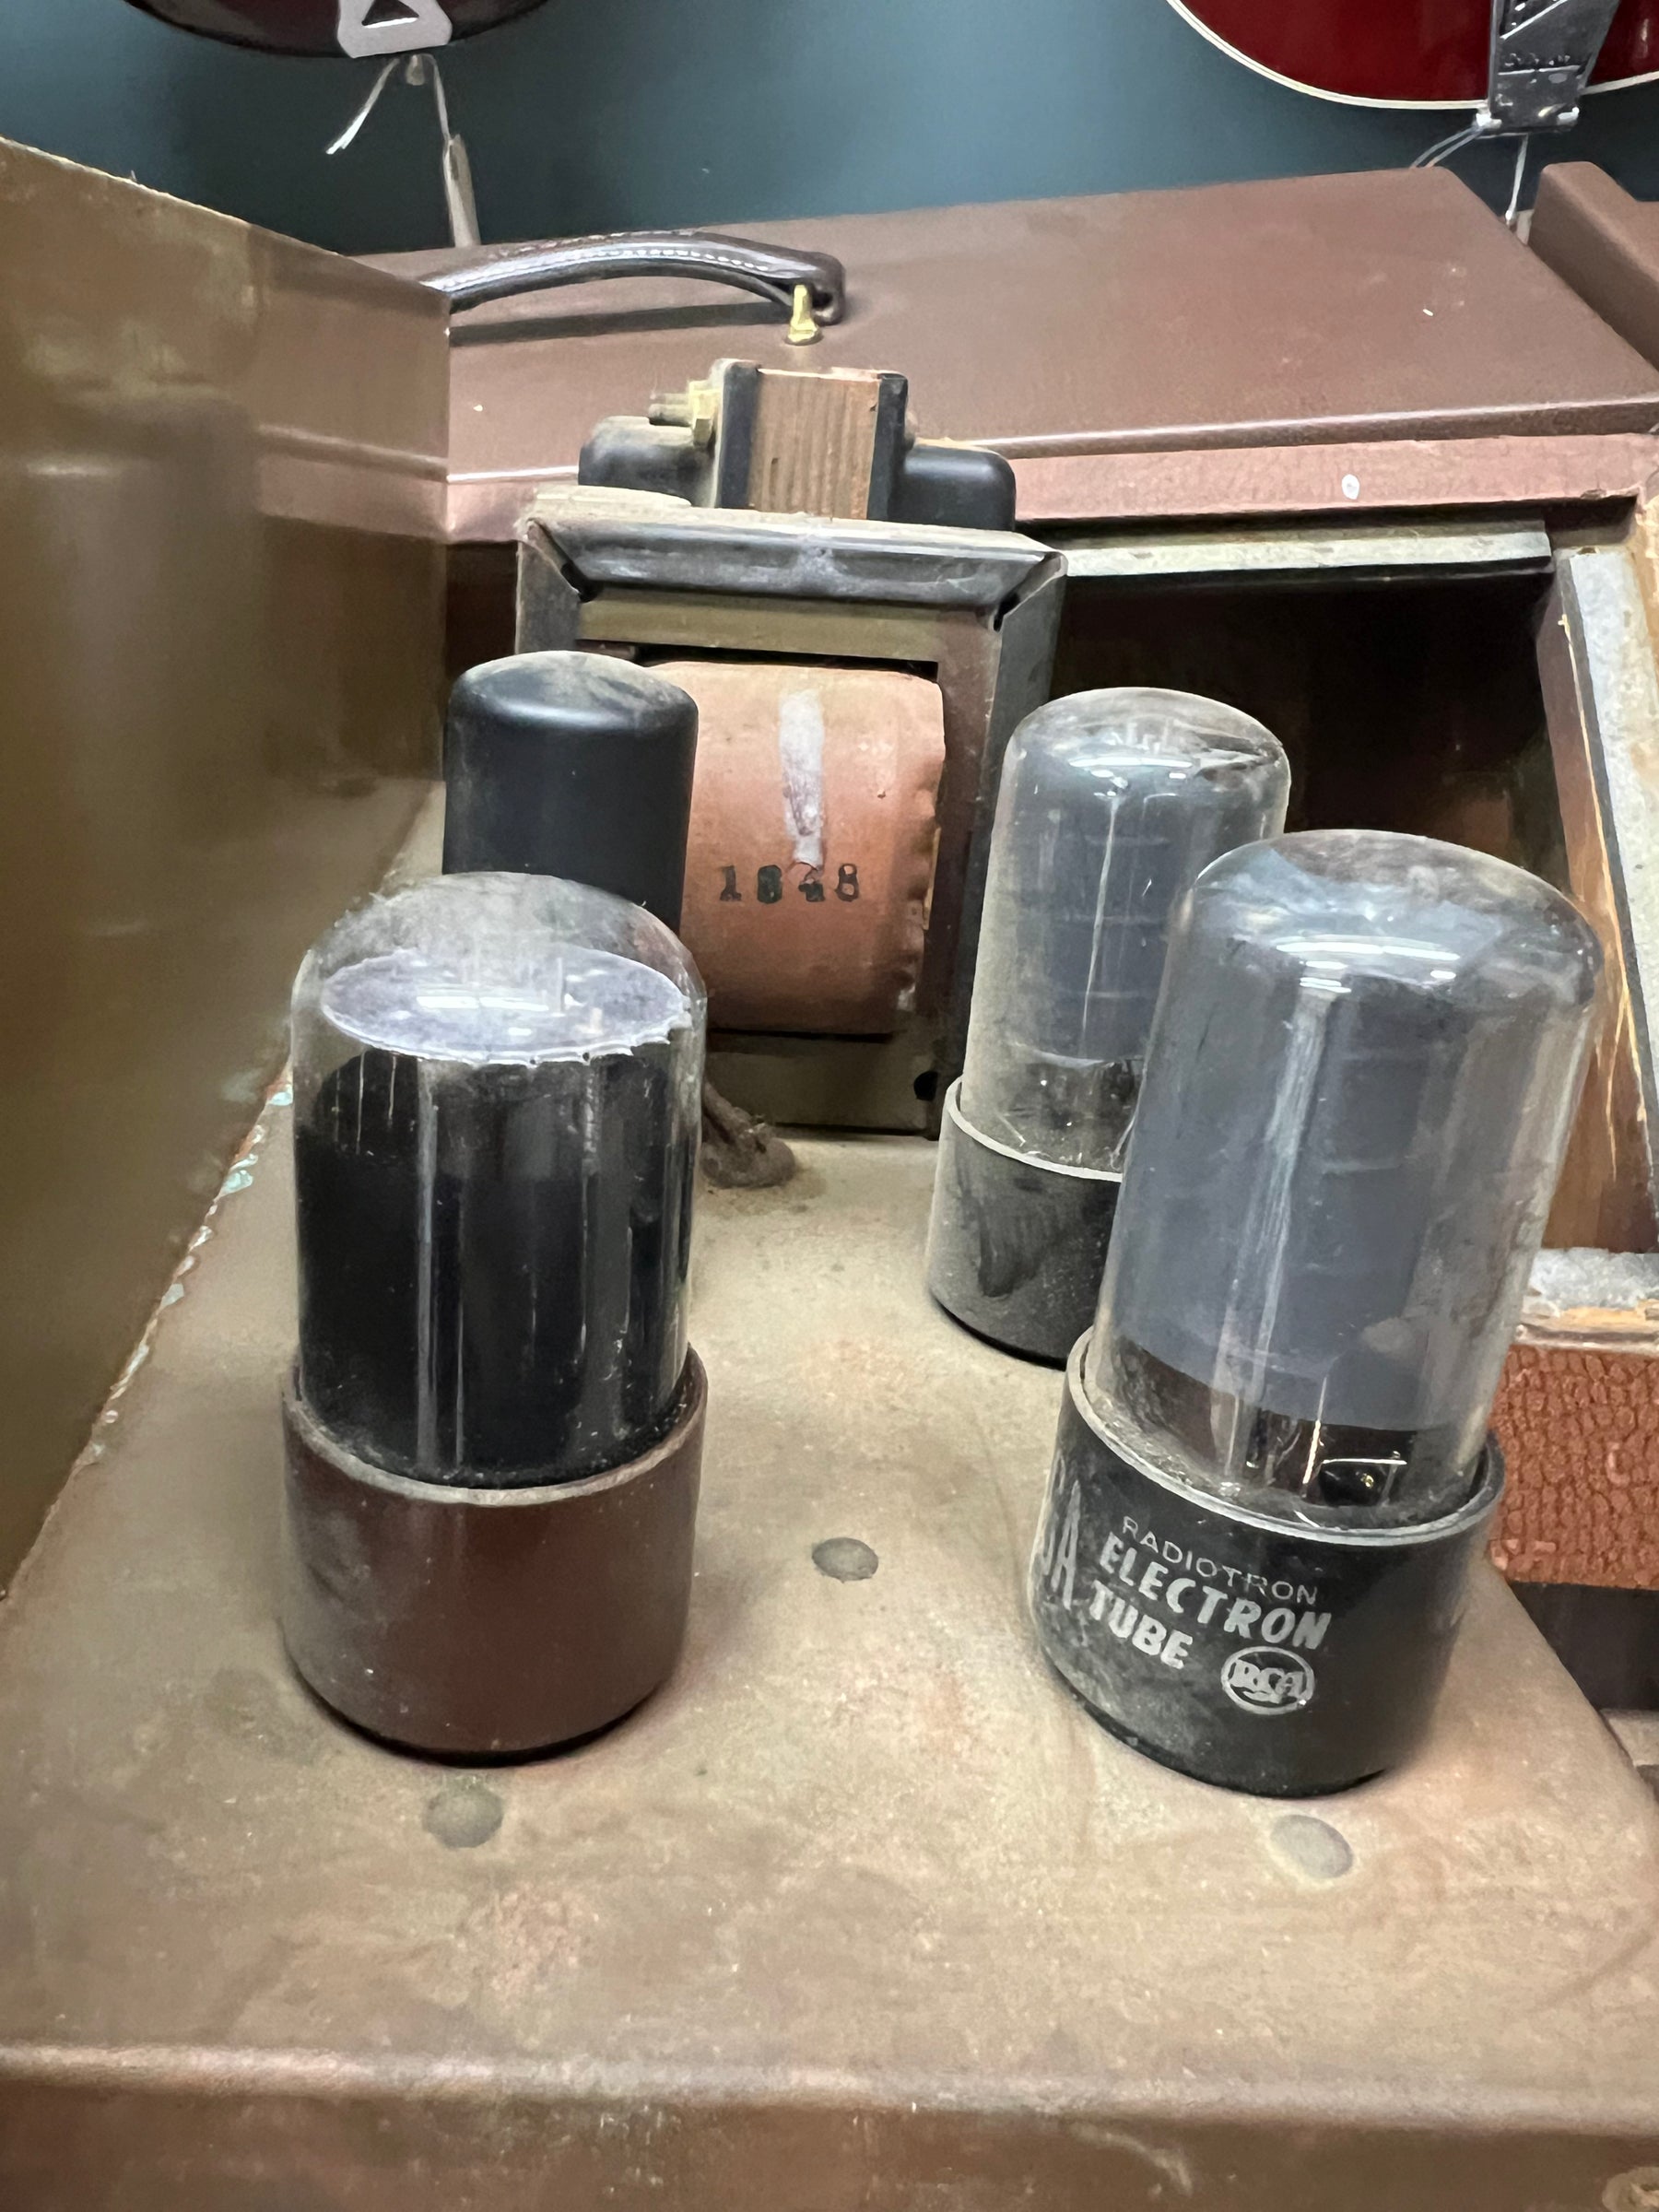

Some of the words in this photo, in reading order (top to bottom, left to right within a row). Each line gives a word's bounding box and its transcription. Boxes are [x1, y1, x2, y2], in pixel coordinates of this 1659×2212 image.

[1100, 1532, 1332, 1650] ELECTRON
[1122, 1516, 1318, 1605] RADIOTRON
[1088, 1579, 1194, 1669] TUBE
[1226, 1656, 1308, 1706] RCA
